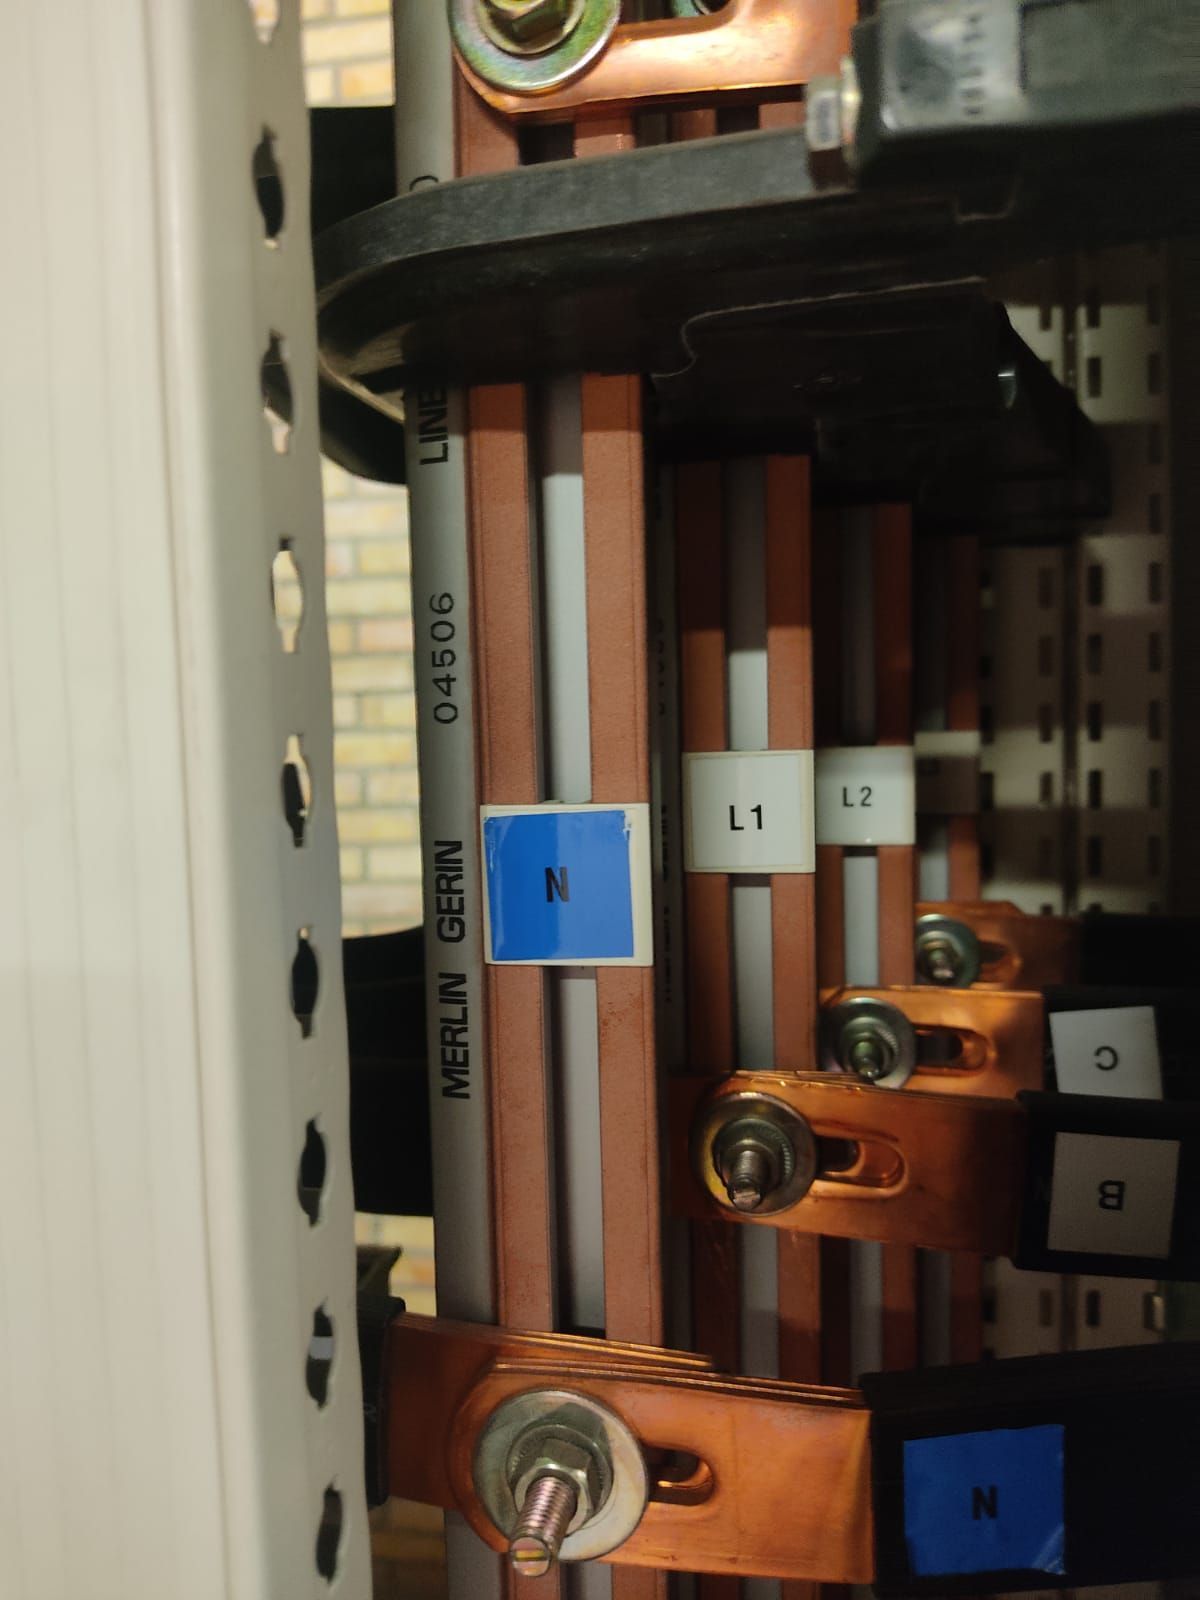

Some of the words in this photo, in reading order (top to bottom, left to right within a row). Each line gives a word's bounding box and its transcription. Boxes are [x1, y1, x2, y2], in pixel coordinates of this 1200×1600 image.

[429, 592, 458, 724] 04506
[842, 786, 872, 808] L2
[728, 804, 763, 831] L1
[434, 840, 465, 943] GERIN
[544, 866, 570, 903] N
[438, 972, 470, 1100] MERLIN
[1094, 1045, 1118, 1071] C
[1098, 1179, 1125, 1211] B
[971, 1486, 998, 1521] N
